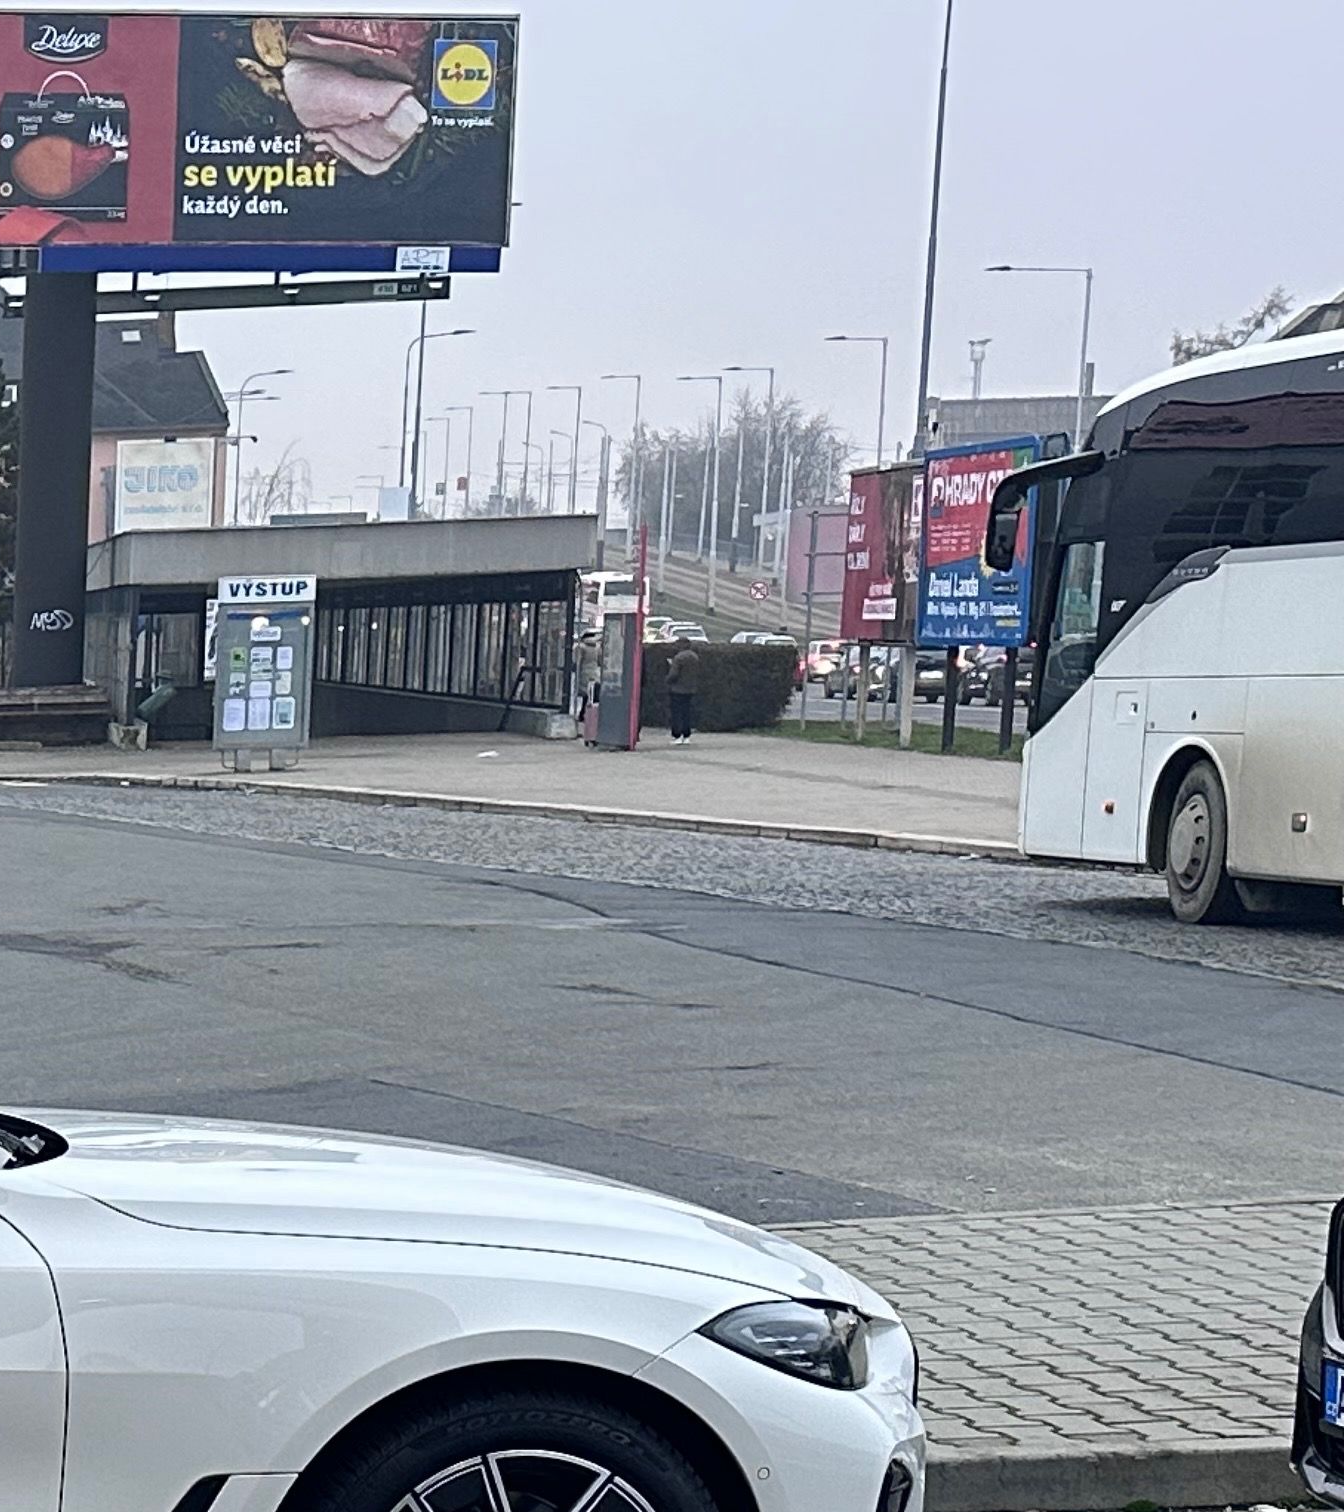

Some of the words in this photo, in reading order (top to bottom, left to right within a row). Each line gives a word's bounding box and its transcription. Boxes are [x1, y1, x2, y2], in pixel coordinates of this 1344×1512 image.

[31, 24, 102, 53] Deluxe
[184, 130, 256, 154] Úžasné
[261, 134, 301, 154] věci
[183, 164, 218, 187] se
[226, 157, 338, 194] vyplatí
[182, 195, 241, 219] každý
[245, 195, 289, 214] den.
